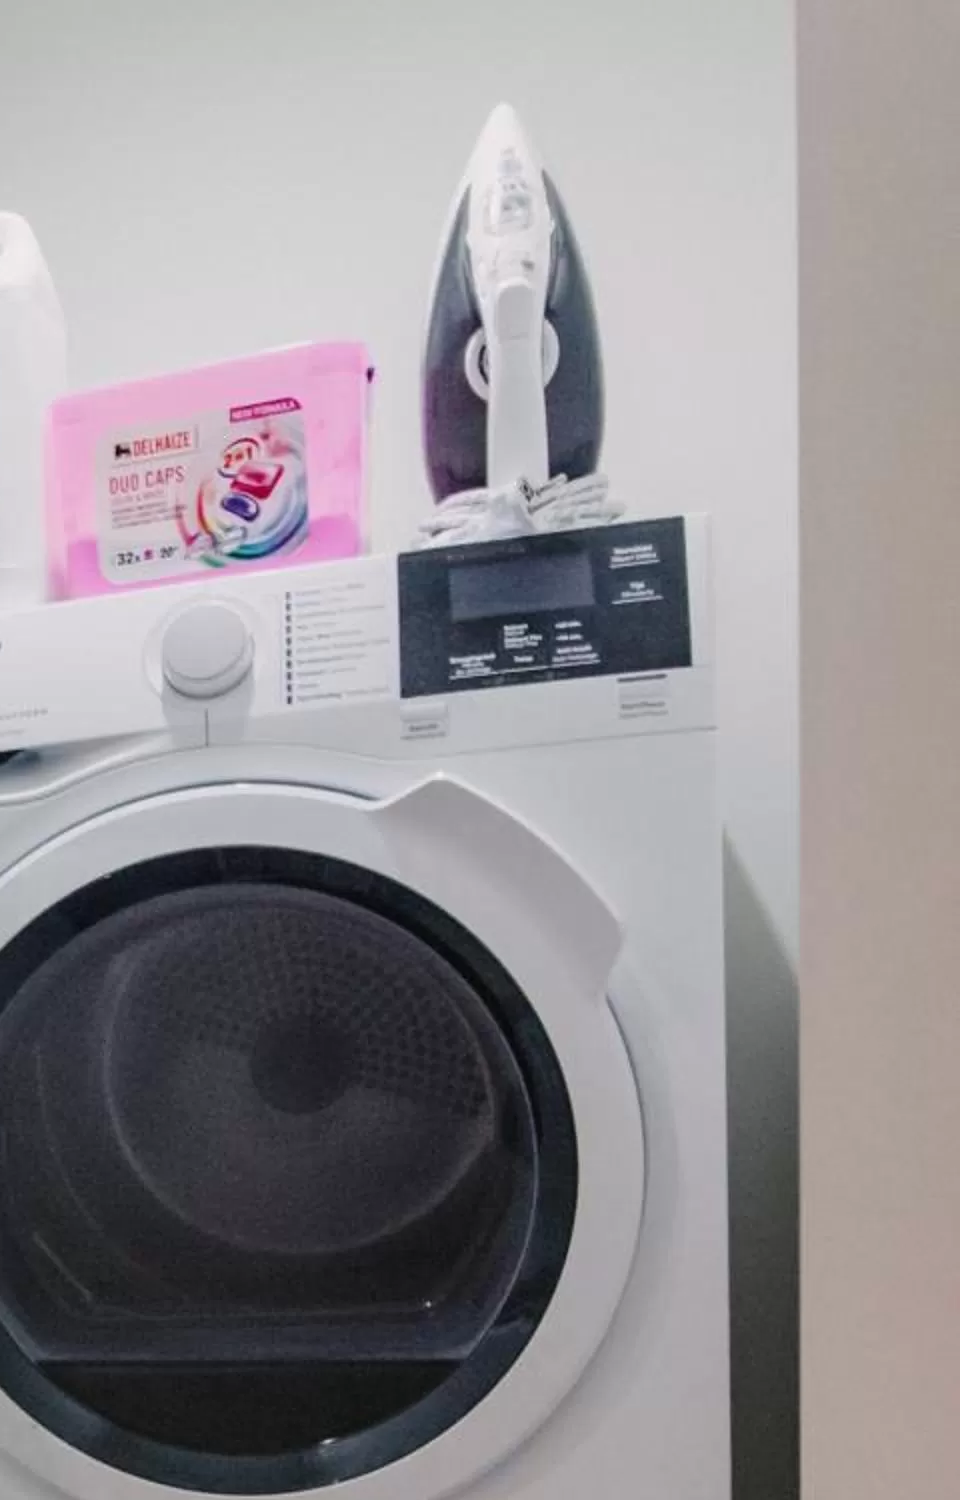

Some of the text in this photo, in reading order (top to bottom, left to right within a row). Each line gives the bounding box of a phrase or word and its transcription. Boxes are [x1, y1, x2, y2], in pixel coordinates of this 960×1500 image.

[132, 431, 191, 457] DELHAIZE
[109, 466, 186, 495] DUO CAPS
